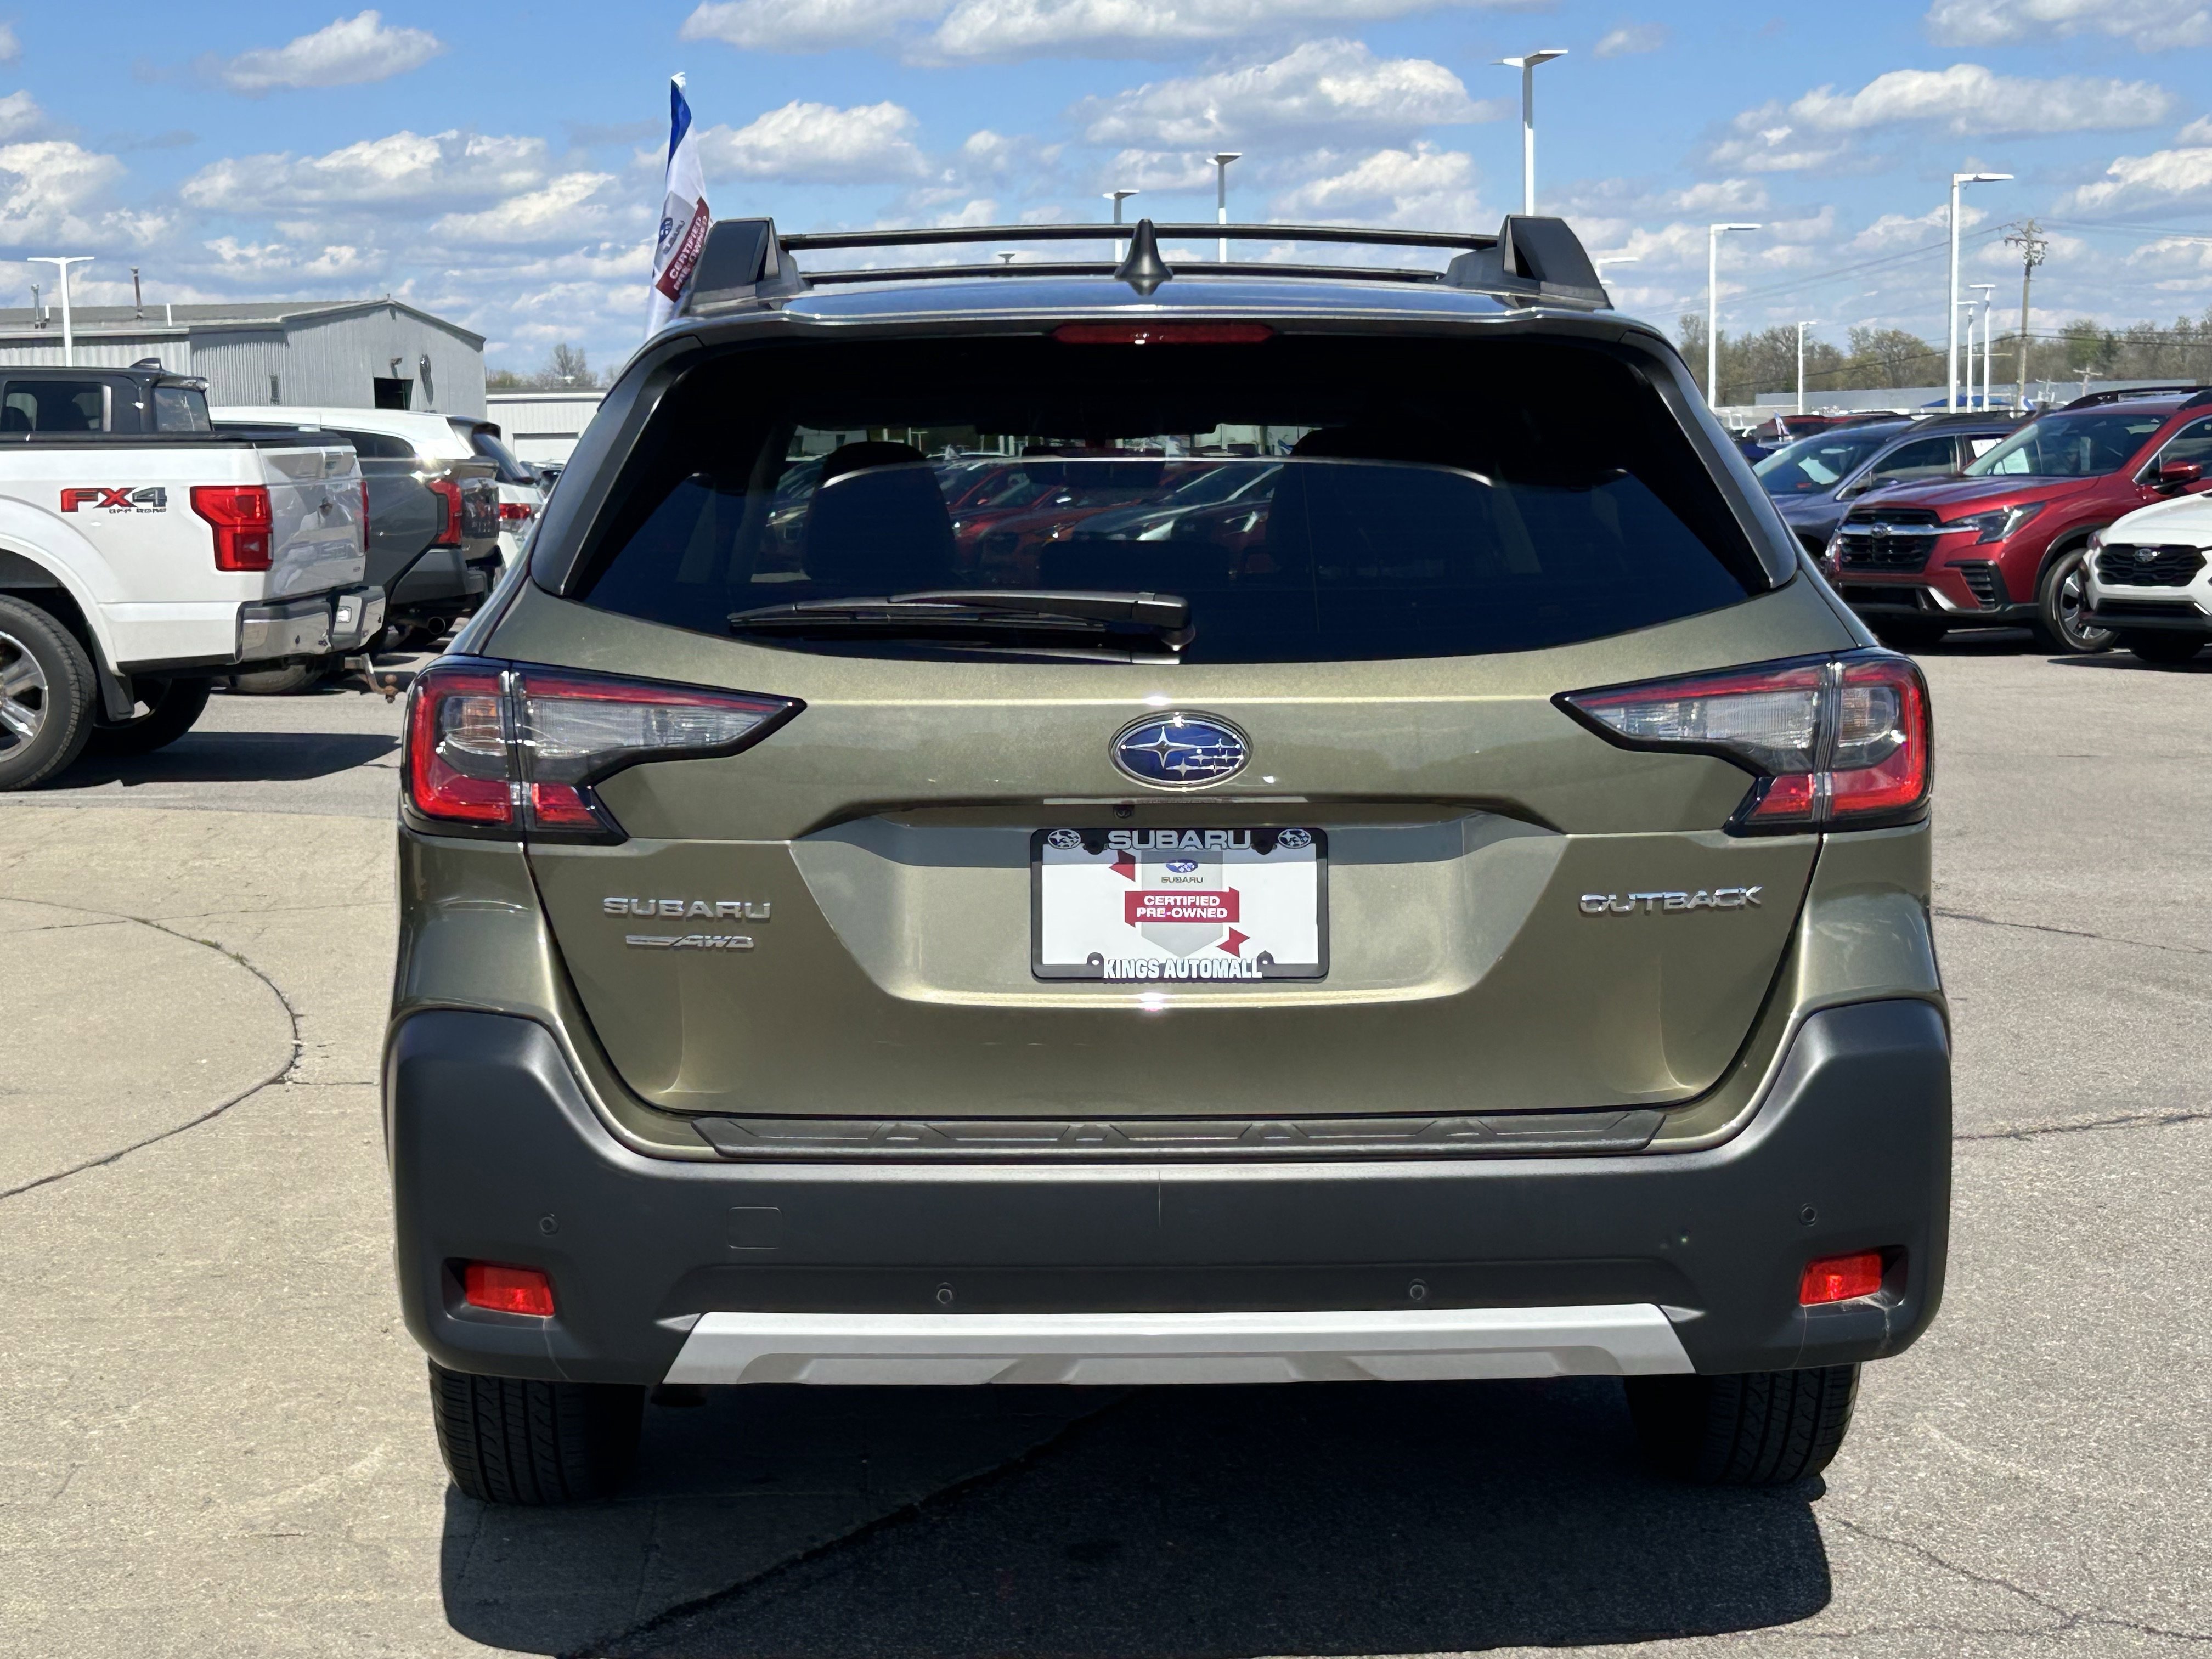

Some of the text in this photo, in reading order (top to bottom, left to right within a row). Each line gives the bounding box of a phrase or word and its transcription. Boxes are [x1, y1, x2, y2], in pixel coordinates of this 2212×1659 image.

[60, 487, 167, 512] FX4
[1108, 830, 1251, 850] SUBARU
[603, 897, 770, 918] SUBARU
[1144, 896, 1221, 906] CERTIFIED
[1579, 886, 1763, 913] OUTBACK
[1136, 908, 1228, 918] PRE-OWNED
[673, 935, 754, 949] AWD
[1103, 958, 1262, 978] KINGS AUTOMALL
